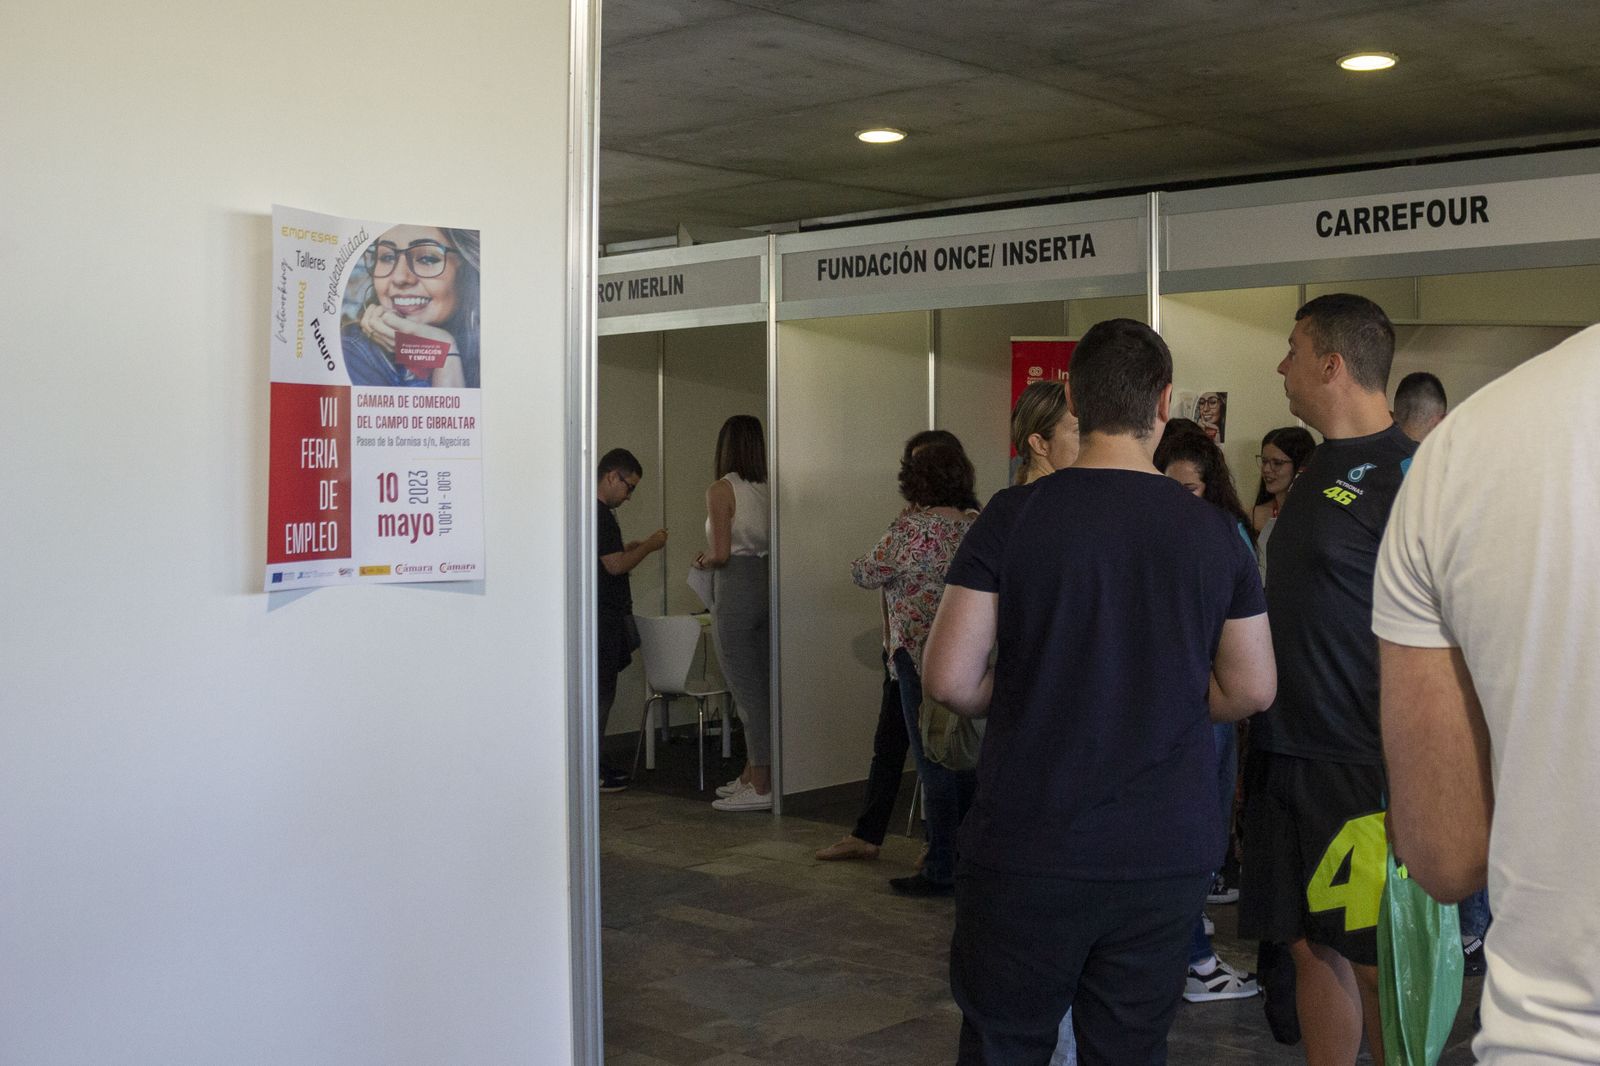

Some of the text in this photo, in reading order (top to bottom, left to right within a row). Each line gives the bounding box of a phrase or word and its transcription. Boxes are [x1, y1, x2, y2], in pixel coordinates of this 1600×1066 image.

[1316, 195, 1489, 238] CARREFOUR
[296, 250, 326, 271] Talleres
[817, 233, 1096, 281] FUNDACIÓN ONCE/ INSERTA
[598, 274, 684, 303] ROY MERLIN
[296, 281, 307, 359] Ponencias
[310, 318, 335, 371] Futuro
[1058, 368, 1070, 380] In
[320, 397, 338, 427] VII
[357, 393, 461, 409] CÁMARA DE COMERCIO
[357, 415, 476, 430] DEL CAMPO DE GIBRALTAR
[301, 438, 339, 469] FERIA
[356, 436, 376, 447] Paseo
[377, 436, 386, 447] de
[387, 436, 394, 447] la
[439, 436, 471, 449] Algeciras
[319, 480, 338, 510] DE
[377, 472, 399, 503] 10
[408, 470, 429, 505] 2023
[1322, 486, 1358, 506] 46
[1336, 480, 1363, 495] PETRONAS
[285, 521, 338, 555] EMPLEO
[377, 512, 434, 544] mayo
